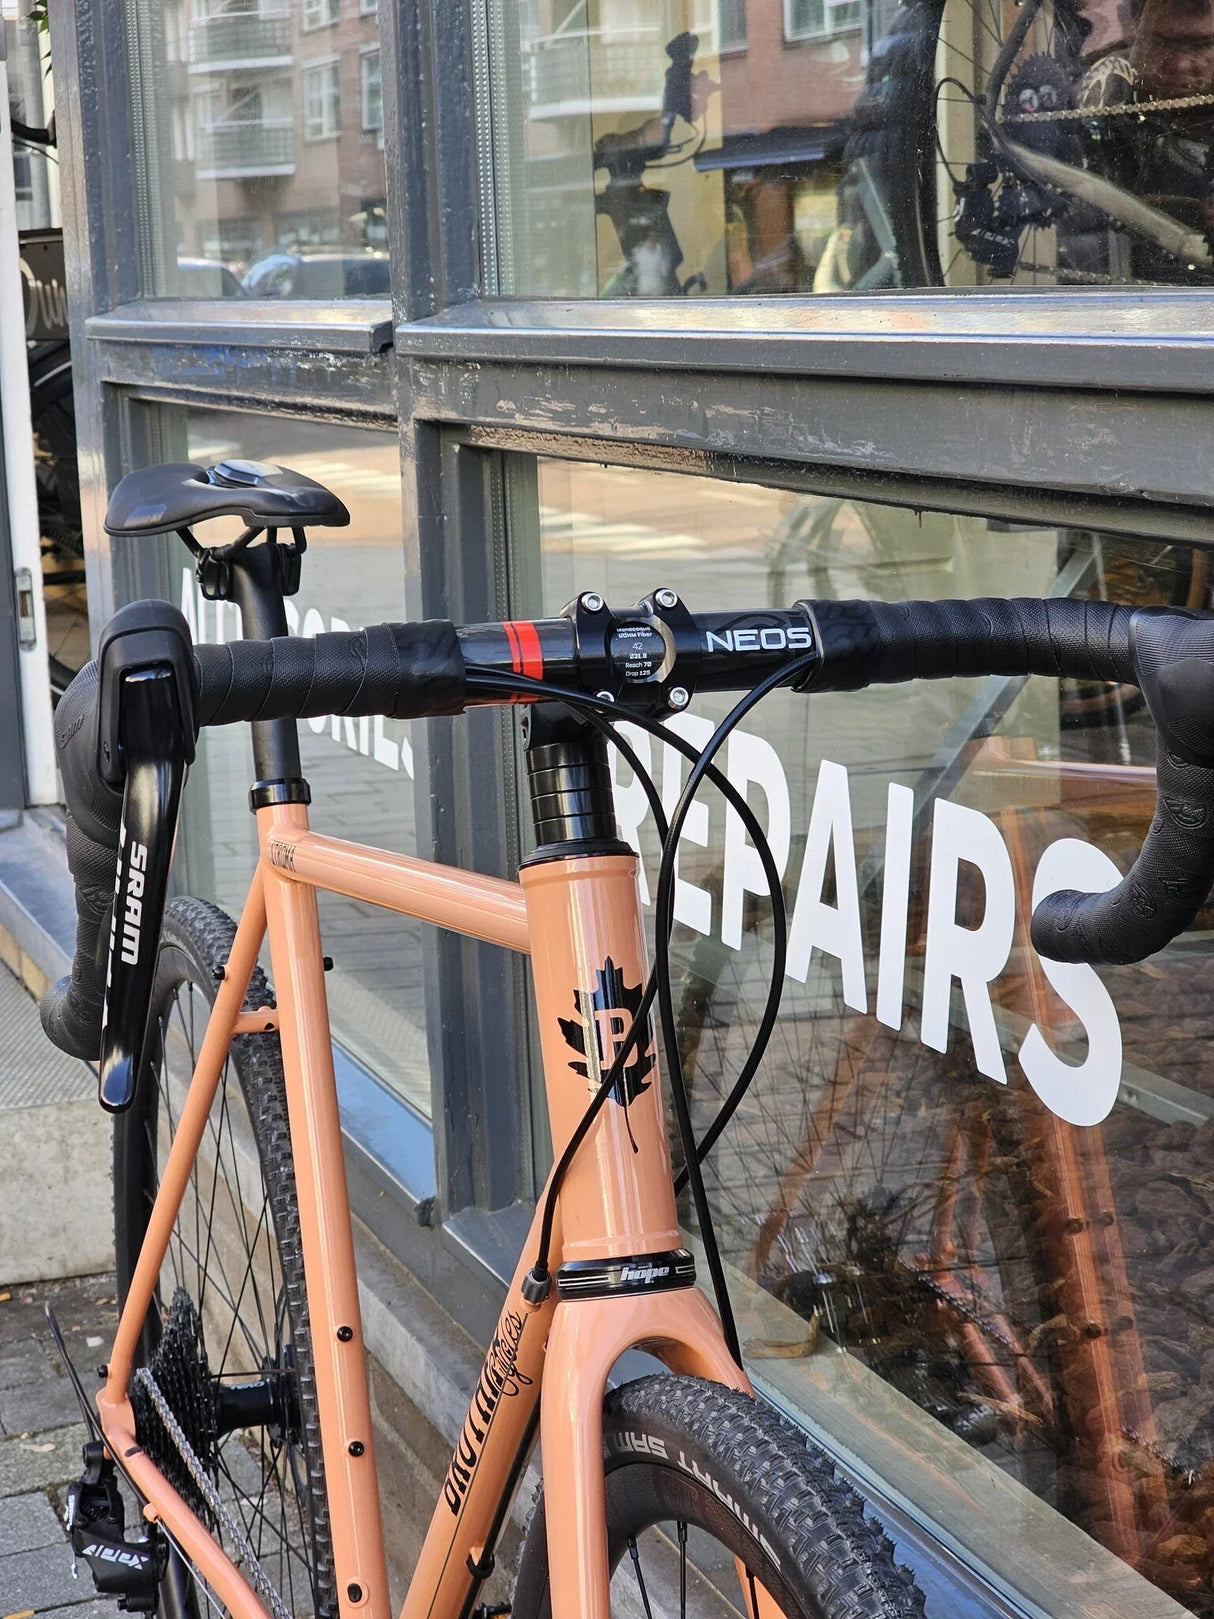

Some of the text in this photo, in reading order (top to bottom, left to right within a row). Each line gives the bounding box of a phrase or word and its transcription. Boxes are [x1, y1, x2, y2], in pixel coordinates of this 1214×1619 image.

[632, 642, 643, 650] 42
[705, 627, 812, 653] NEOS
[120, 840, 148, 966] SRAM
[607, 712, 1123, 1127] REPAIRS
[620, 1264, 671, 1284] hope
[612, 1431, 782, 1572] SMART SAM
[81, 1544, 150, 1571] APEX
